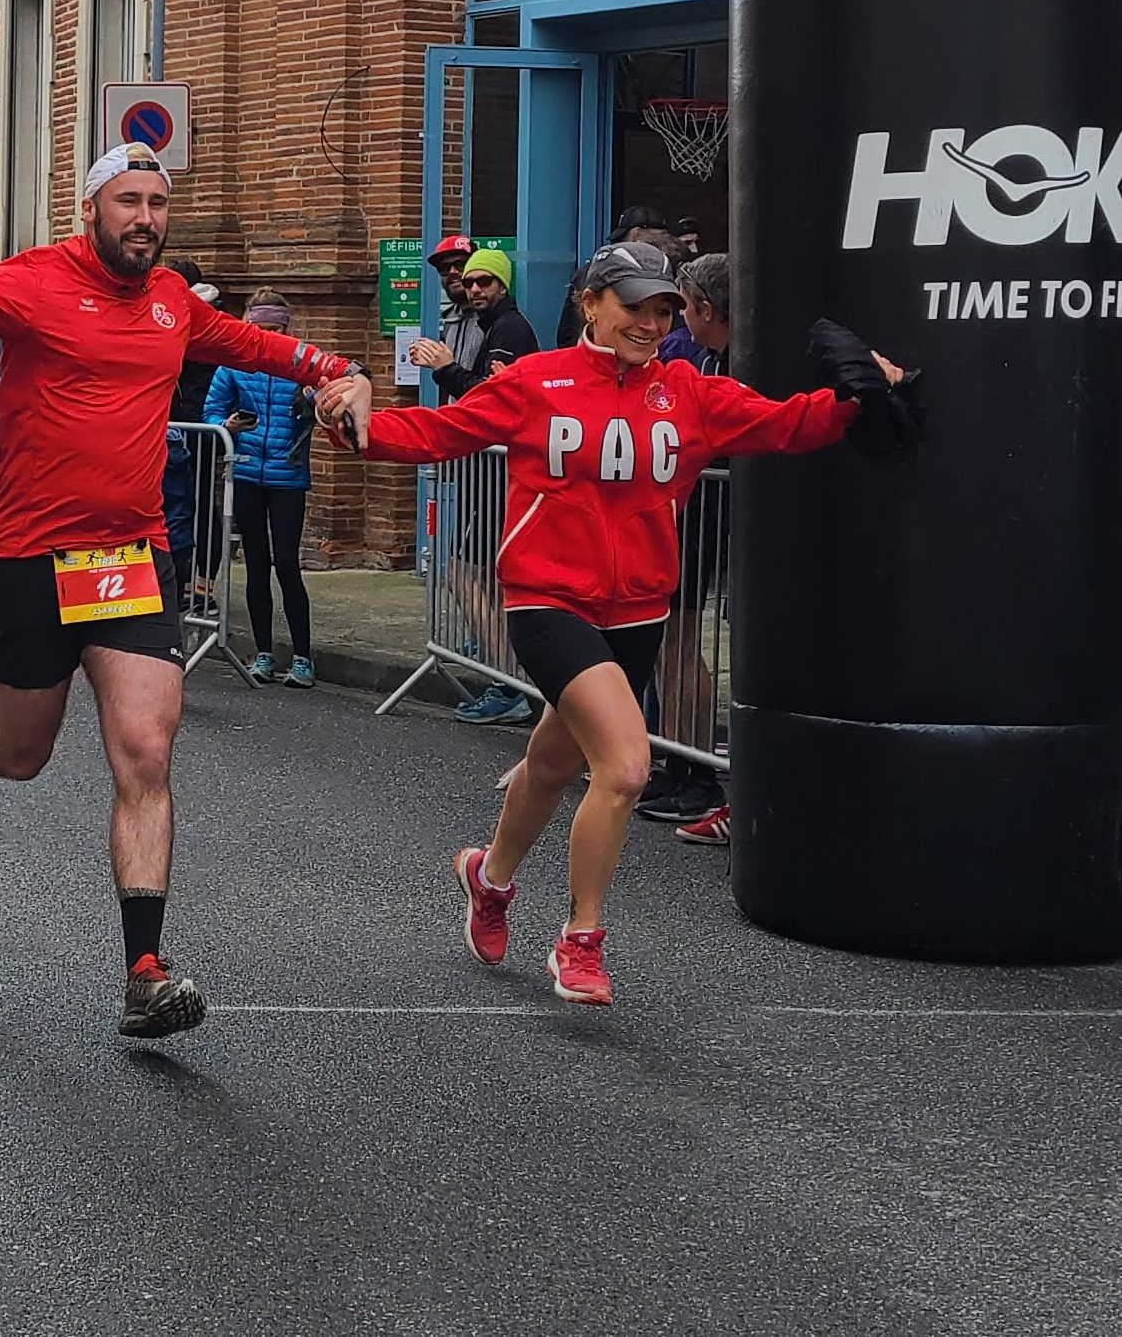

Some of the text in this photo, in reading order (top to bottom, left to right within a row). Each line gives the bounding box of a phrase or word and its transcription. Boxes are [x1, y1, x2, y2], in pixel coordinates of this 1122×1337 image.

[923, 280, 1030, 320] TIME
[1040, 279, 1093, 319] TO
[548, 416, 680, 483] PAC
[96, 574, 127, 602] 12
